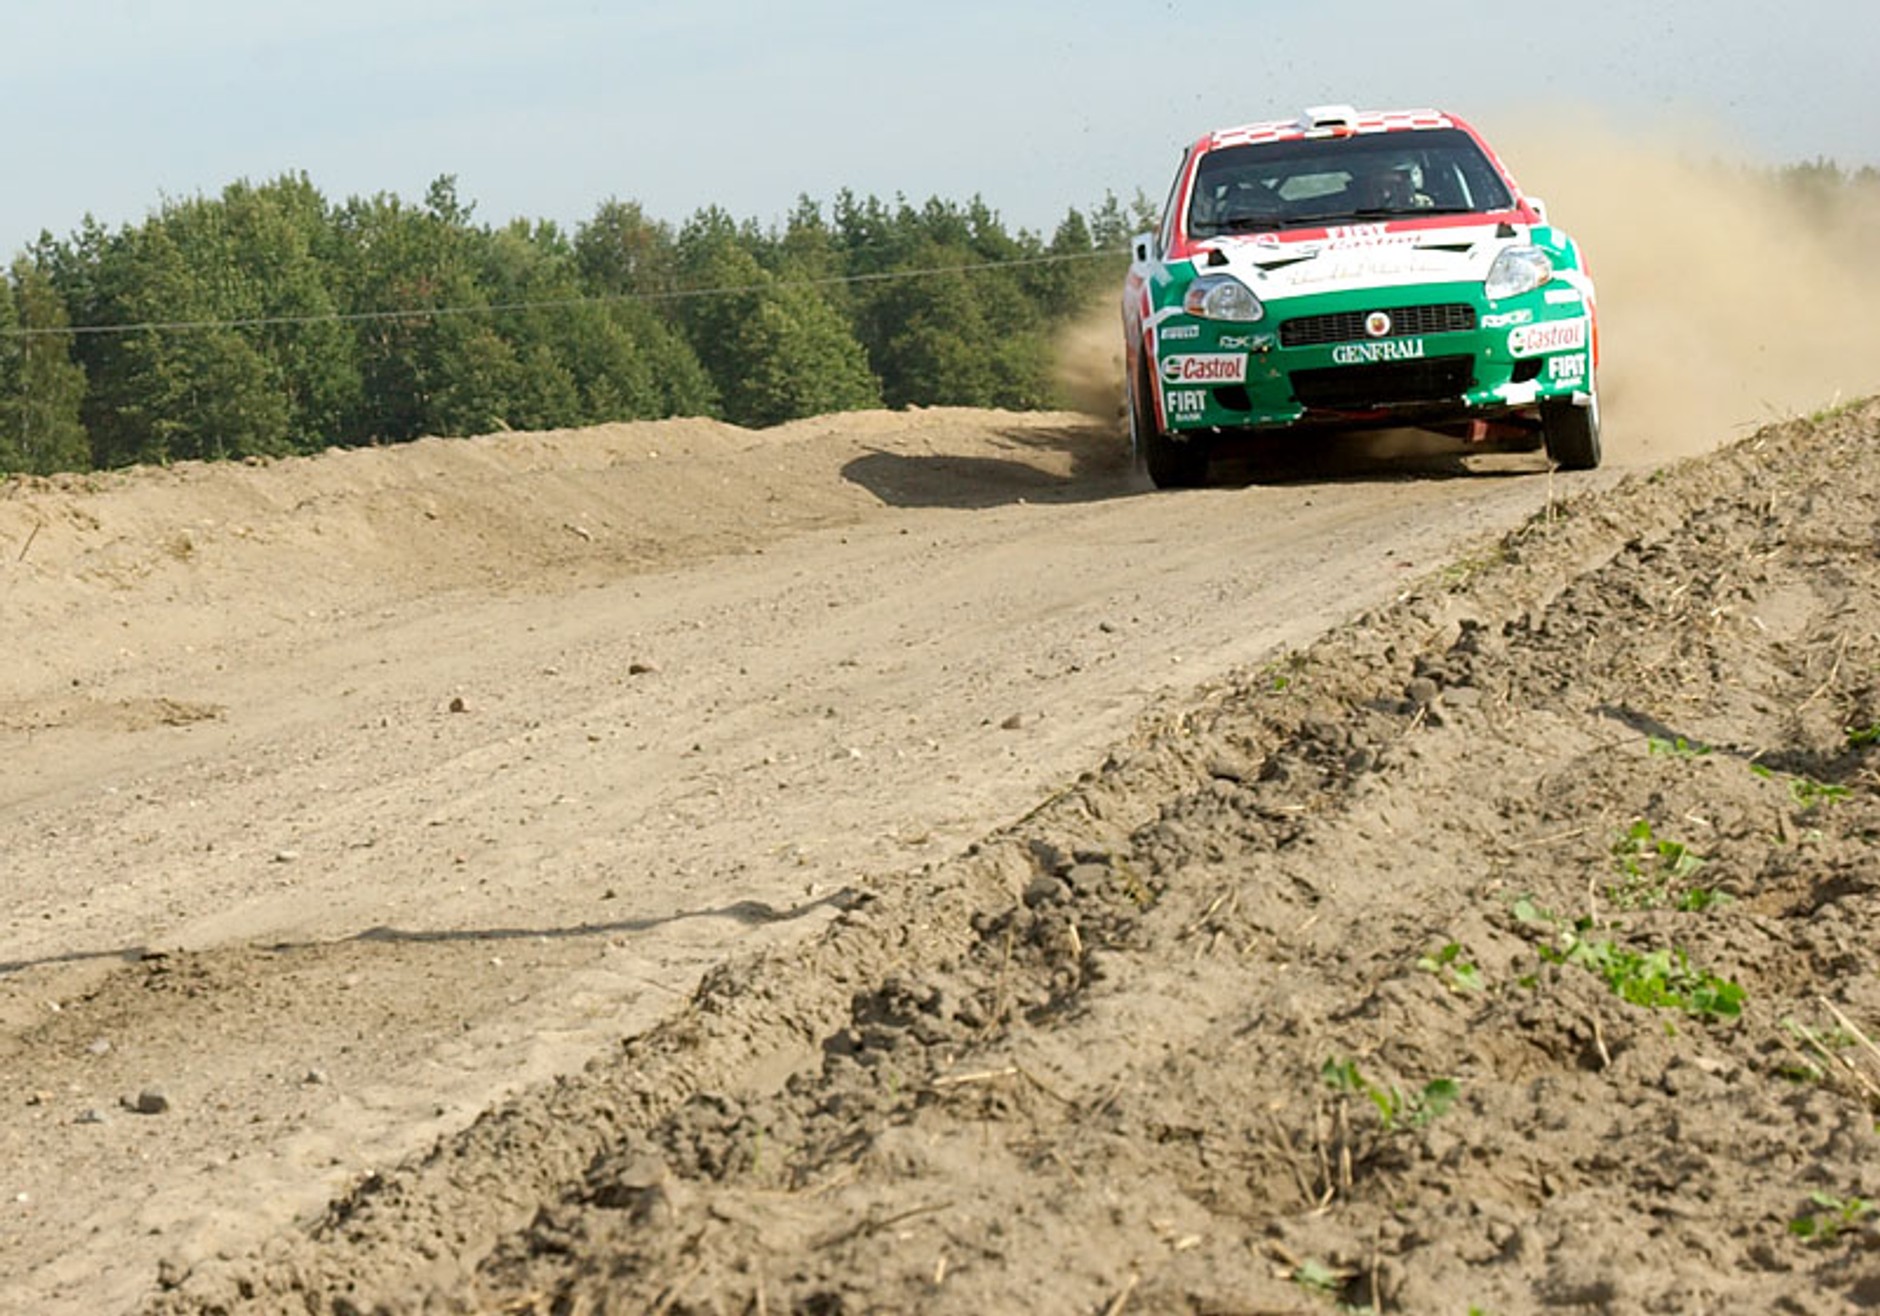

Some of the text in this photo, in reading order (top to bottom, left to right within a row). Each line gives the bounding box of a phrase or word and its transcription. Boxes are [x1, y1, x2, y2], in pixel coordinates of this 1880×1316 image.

[1527, 323, 1580, 350] Castrol
[1184, 357, 1242, 379] Castrol
[1548, 353, 1586, 379] FIAT
[1167, 390, 1207, 412] FIAT
